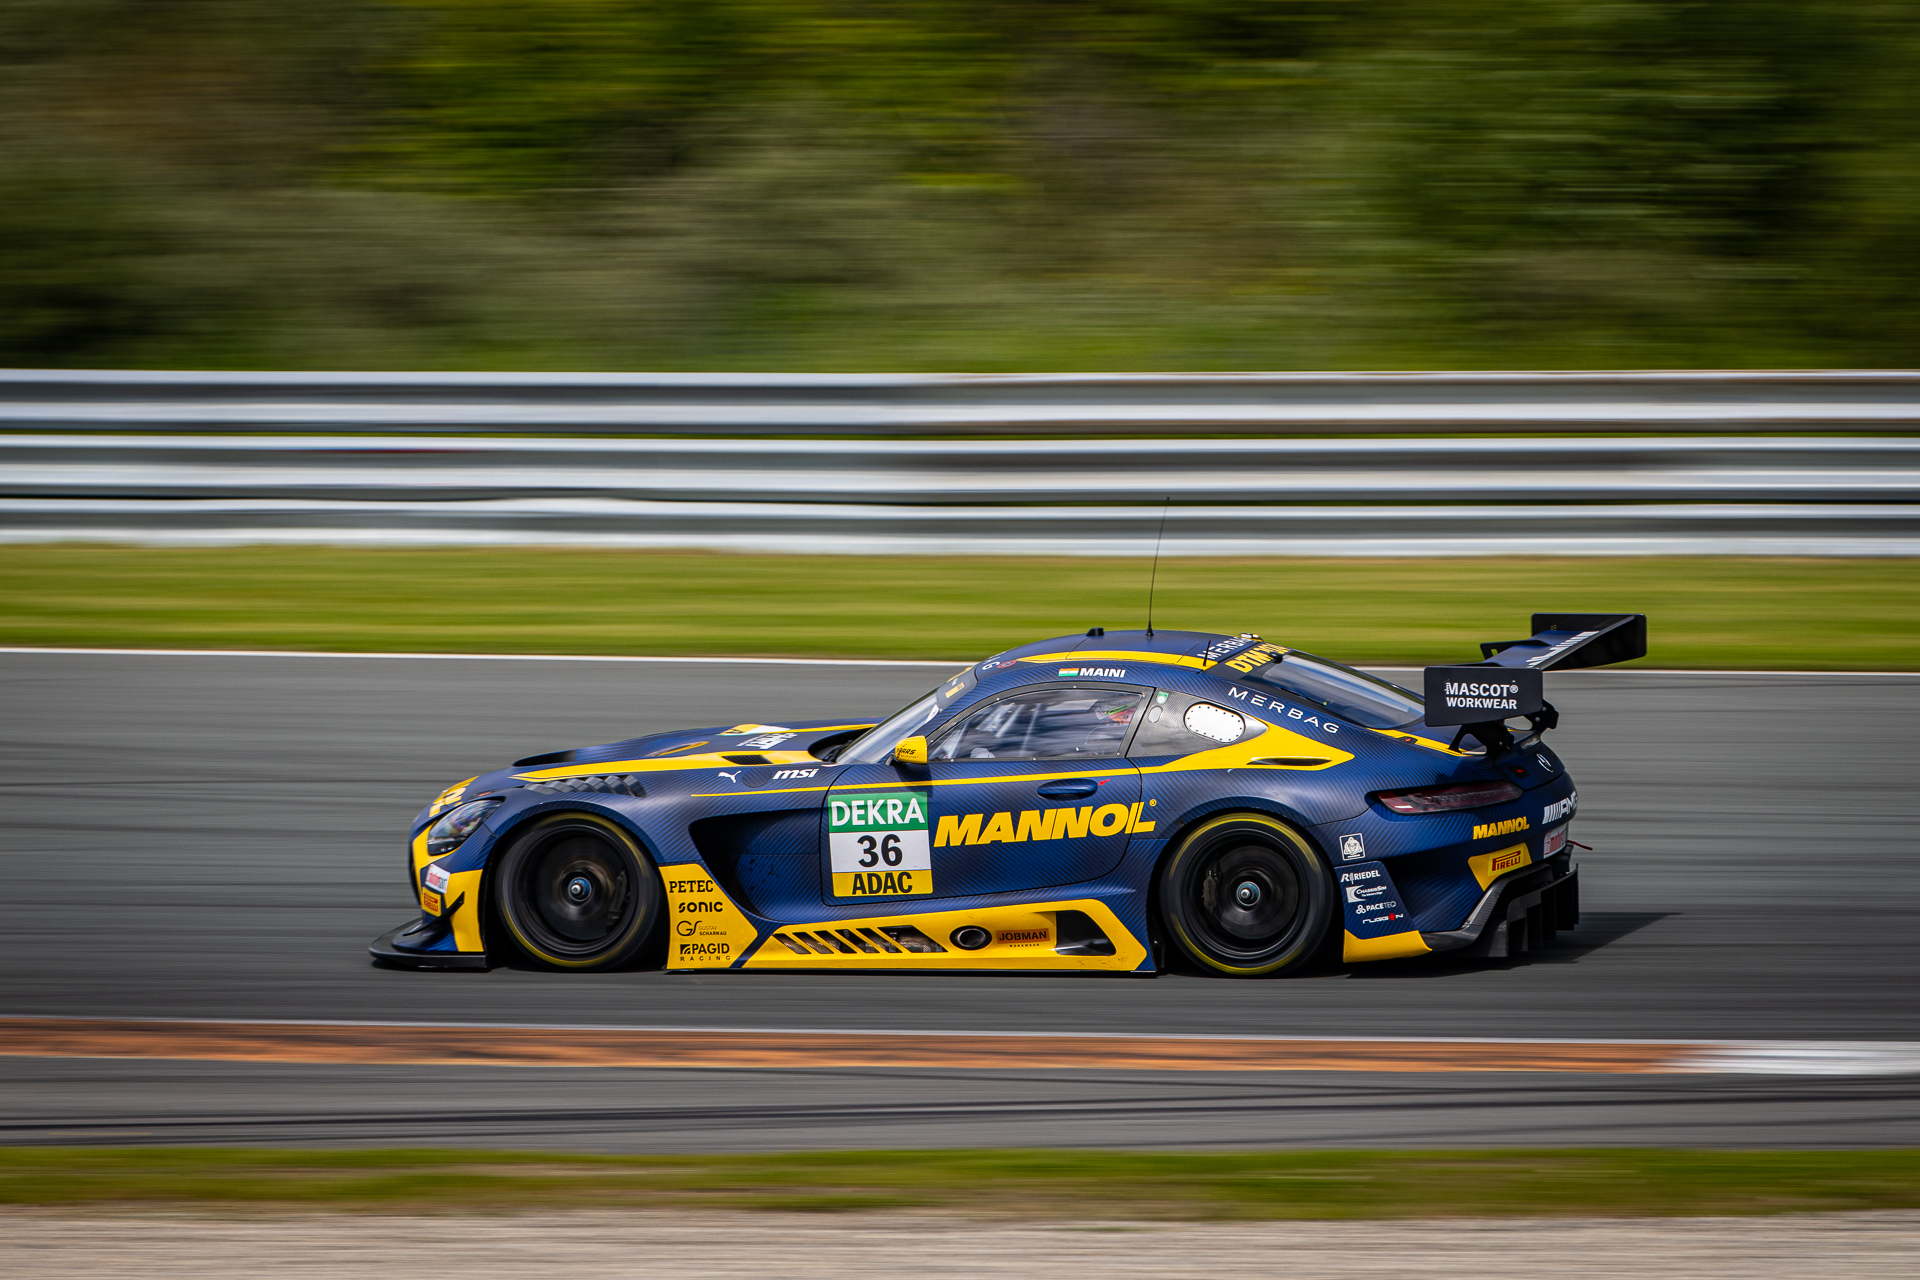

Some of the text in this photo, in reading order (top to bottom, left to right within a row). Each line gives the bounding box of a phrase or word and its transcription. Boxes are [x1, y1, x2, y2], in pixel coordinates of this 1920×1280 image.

[1079, 667, 1126, 678] MAINI
[1446, 697, 1518, 709] WORKWEAR
[1227, 686, 1340, 734] MERBAG
[831, 797, 926, 826] DEKRA
[1472, 816, 1530, 840] MANNOL
[857, 833, 904, 868] 36
[1491, 850, 1522, 872] PIRELLI
[1353, 870, 1381, 881] RIEDEL
[669, 880, 714, 893] PETEC
[851, 871, 913, 895] ADAC
[1366, 901, 1397, 912] PACETEQ
[998, 931, 1048, 941] JOBMAN
[692, 943, 730, 954] PAGID
